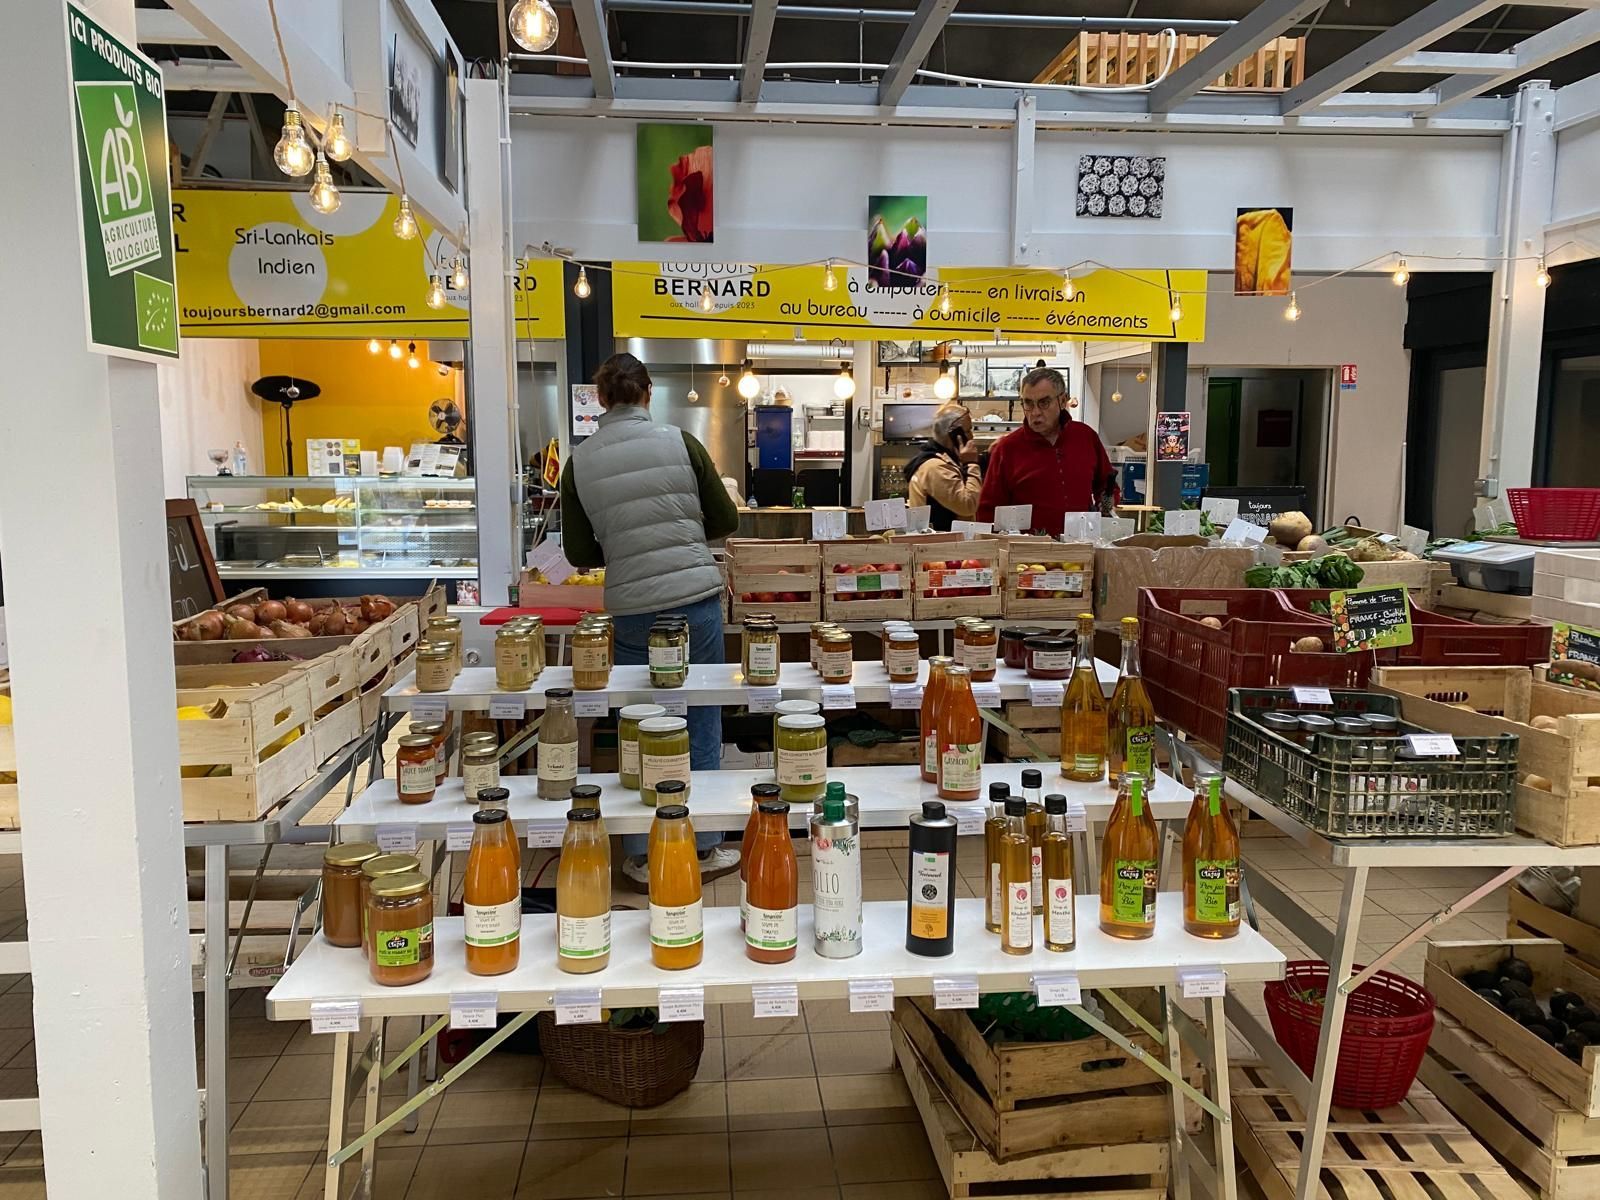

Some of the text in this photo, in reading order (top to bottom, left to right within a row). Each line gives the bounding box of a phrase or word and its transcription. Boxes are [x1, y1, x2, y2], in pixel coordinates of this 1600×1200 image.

[70, 12, 161, 100] ICI PRODUITS BIO
[101, 127, 143, 216] AB
[104, 216, 156, 244] AGRICULTURE
[234, 228, 334, 247] Sri-Lankais
[106, 241, 160, 266] BIOLOGIQUE
[258, 258, 315, 275] Indien
[654, 278, 771, 297] BERNARD
[848, 276, 859, 293] à
[988, 287, 1009, 299] en
[182, 303, 406, 320] toujoursbernard2@gmail.com
[780, 303, 802, 315] au
[807, 298, 867, 317] bureau
[912, 306, 924, 320] à
[1046, 310, 1148, 328] événements
